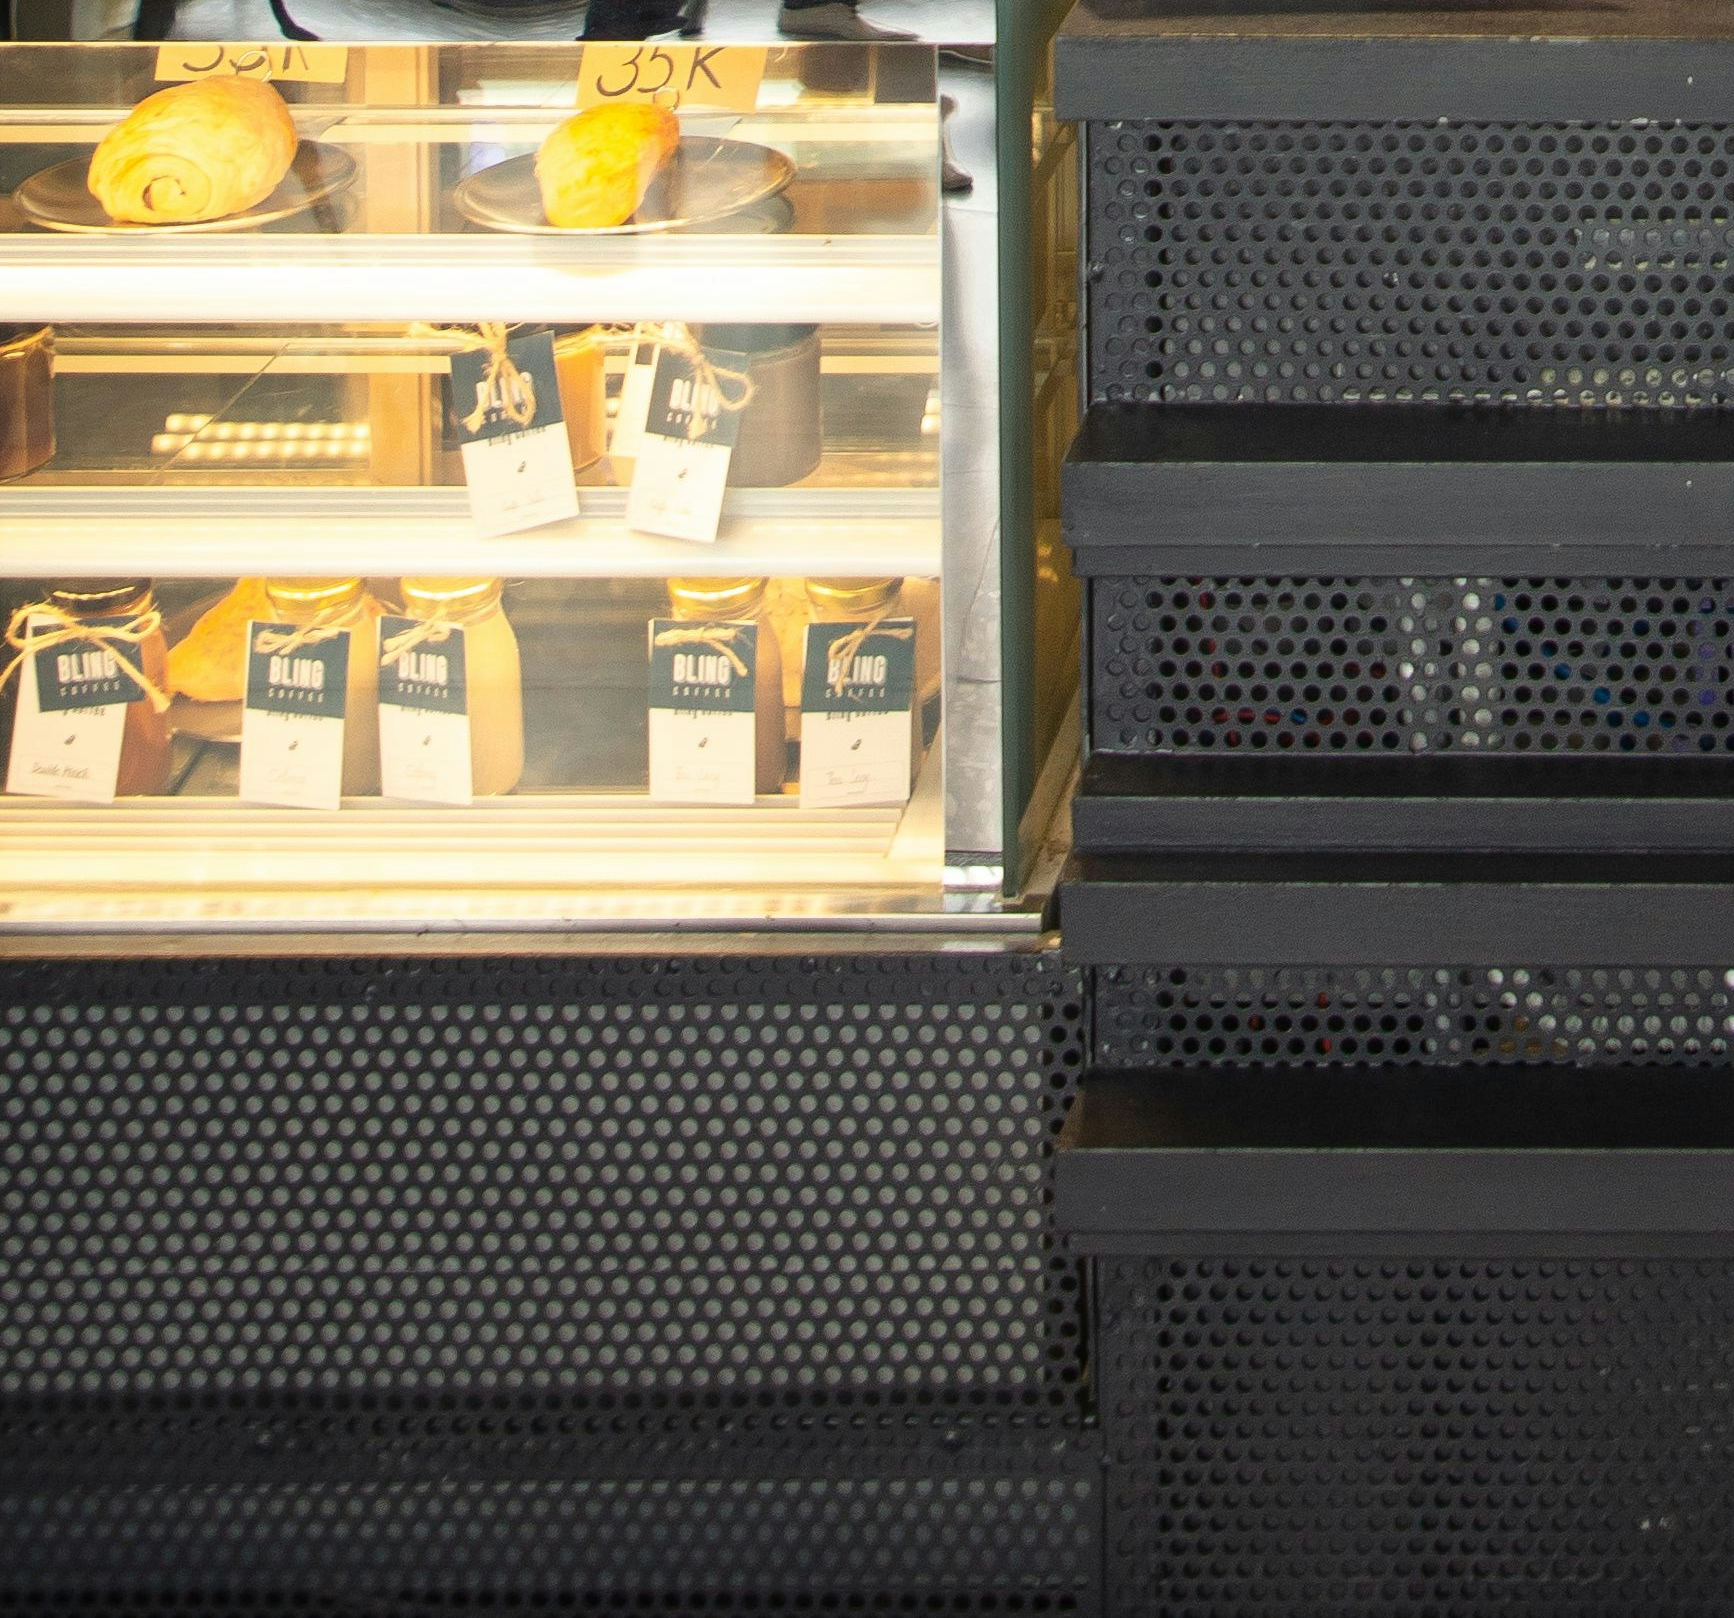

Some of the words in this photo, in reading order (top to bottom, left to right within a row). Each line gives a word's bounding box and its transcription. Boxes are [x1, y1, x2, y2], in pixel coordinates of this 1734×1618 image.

[57, 650, 119, 684] BLING
[268, 654, 325, 691] BLING
[398, 651, 448, 686] BLING
[673, 653, 732, 686] BLING
